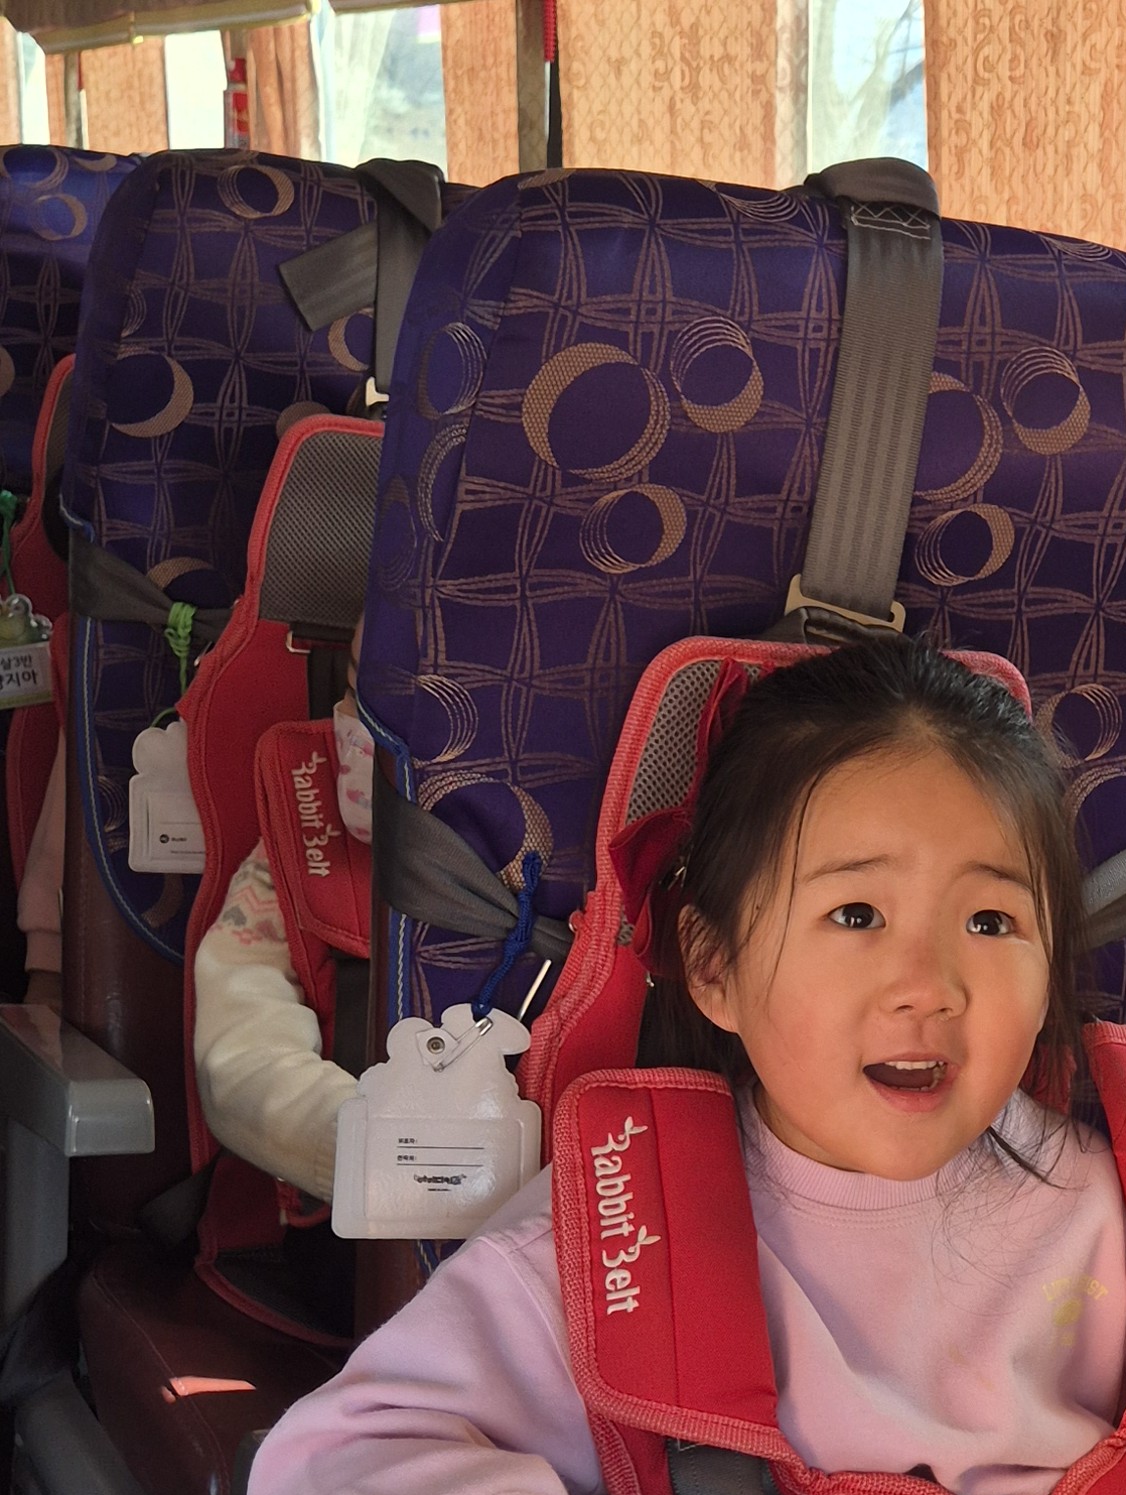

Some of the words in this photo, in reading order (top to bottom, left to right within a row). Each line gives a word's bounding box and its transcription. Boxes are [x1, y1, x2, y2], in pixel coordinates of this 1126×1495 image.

[291, 751, 328, 829] Rabbit
[302, 823, 341, 877] Belt
[591, 1116, 648, 1240] Rabbit
[602, 1224, 662, 1315] Belt
